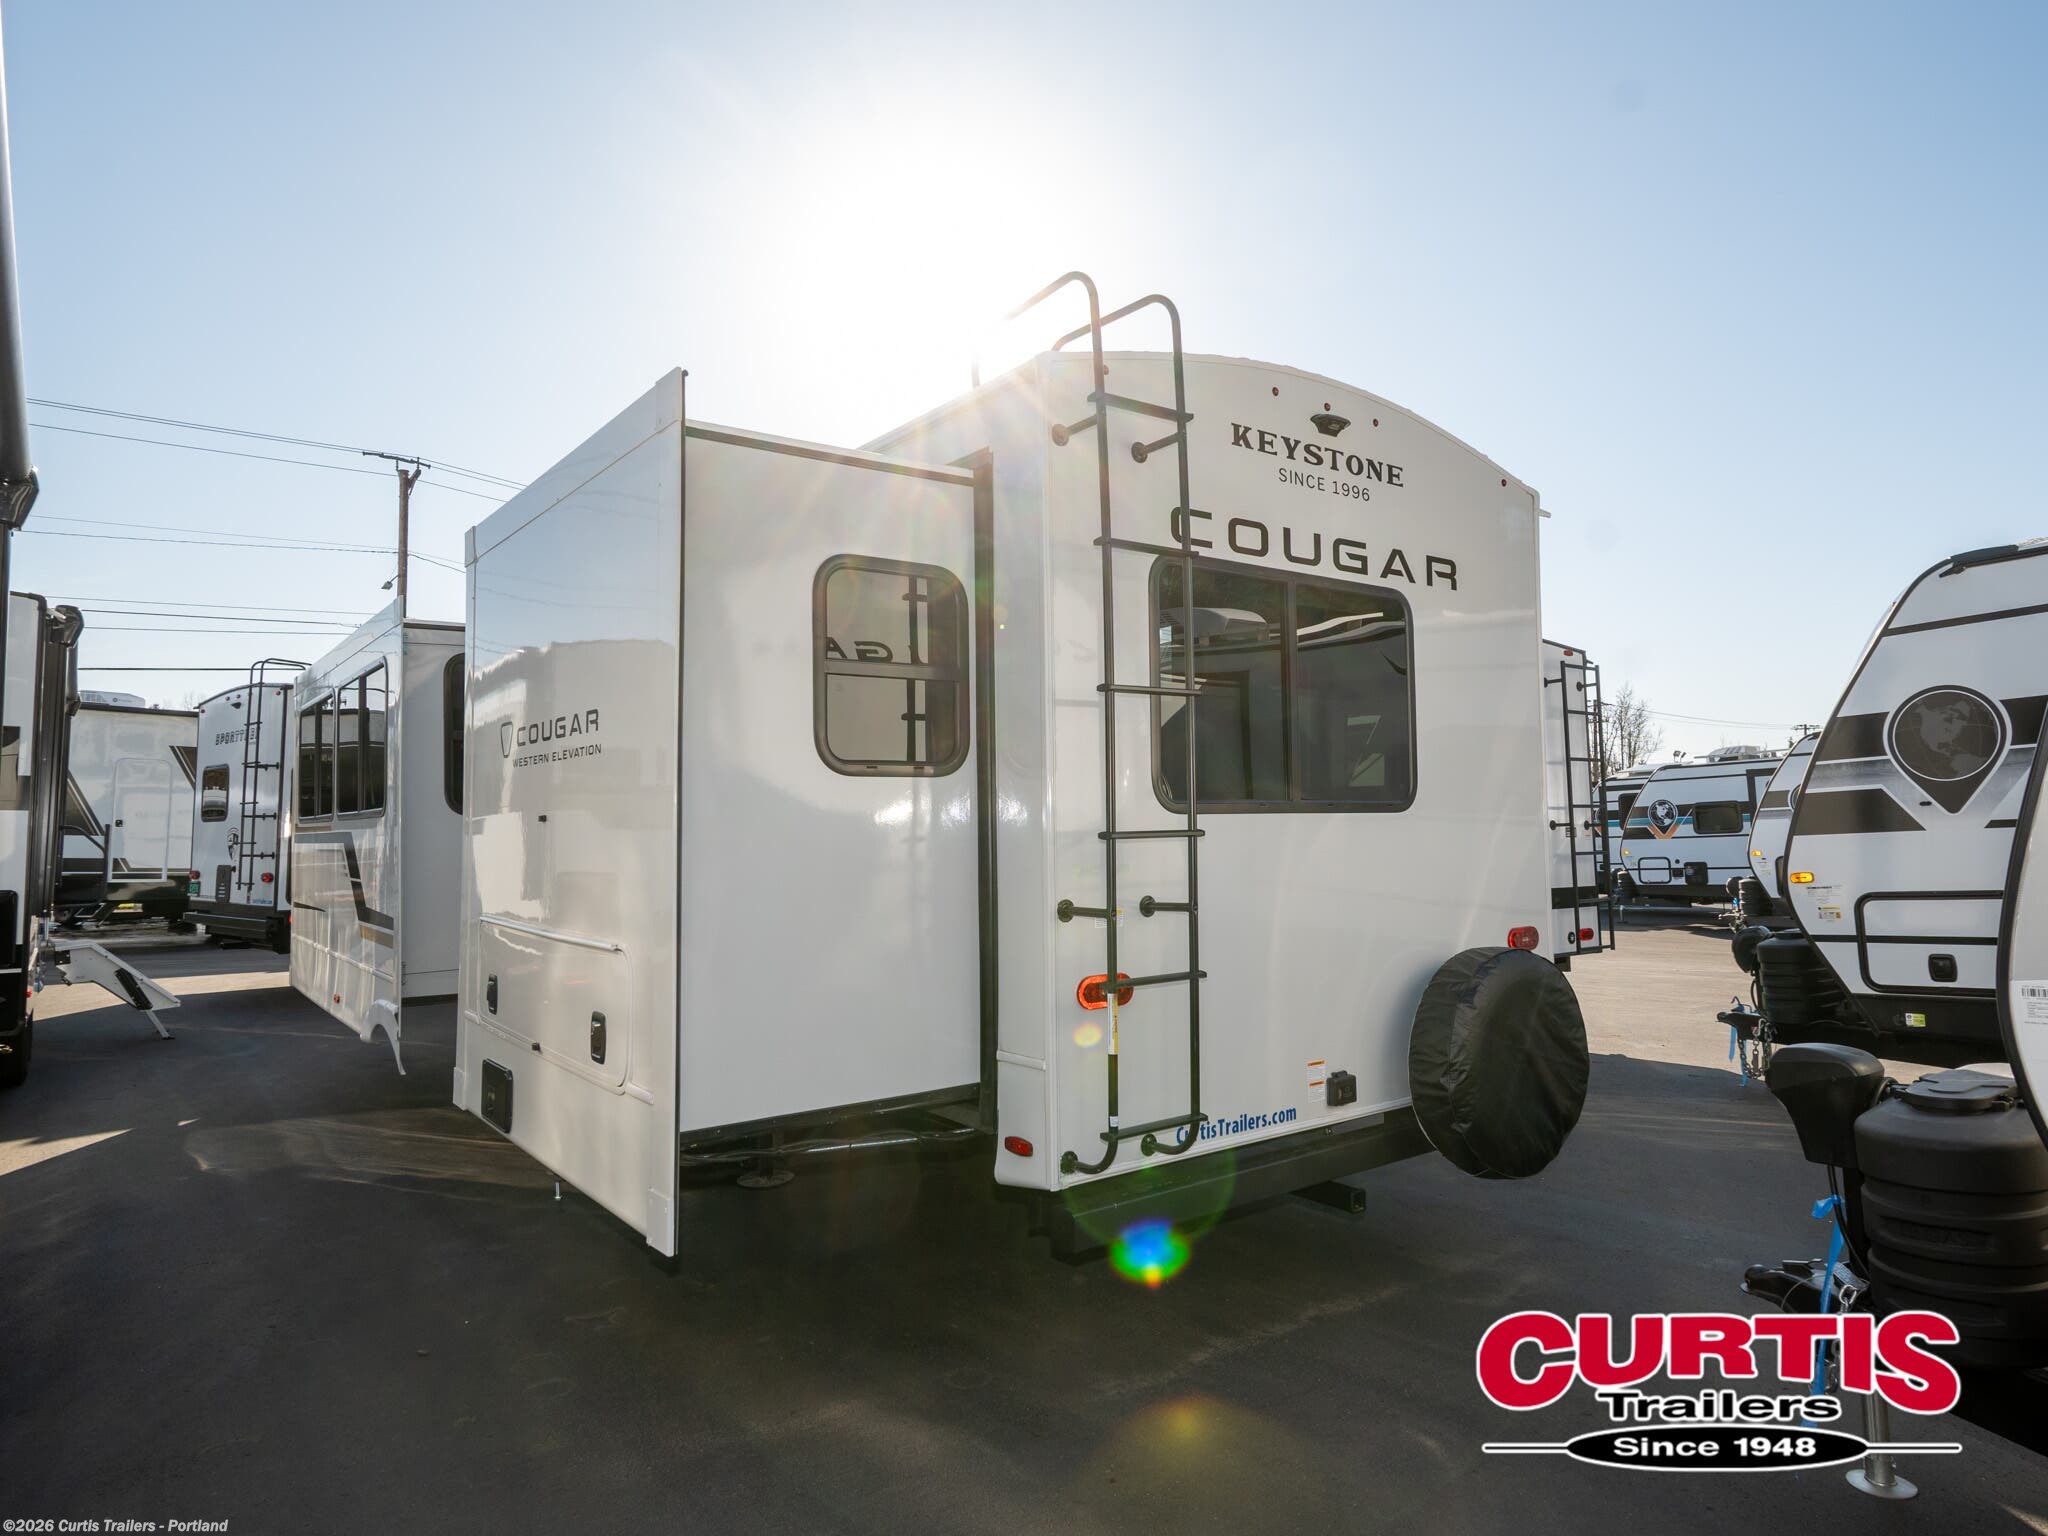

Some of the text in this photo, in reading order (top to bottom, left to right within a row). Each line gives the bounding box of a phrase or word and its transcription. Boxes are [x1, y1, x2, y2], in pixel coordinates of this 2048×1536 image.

[1231, 423, 1404, 488] KEYSTONE
[1278, 467, 1370, 502] SINCE 1996
[1170, 506, 1458, 591] COUGAR
[516, 708, 599, 747] COUGAR
[512, 743, 602, 768] WESTERN ELEVATION
[1176, 1107, 1297, 1146] CtisTrailers.com
